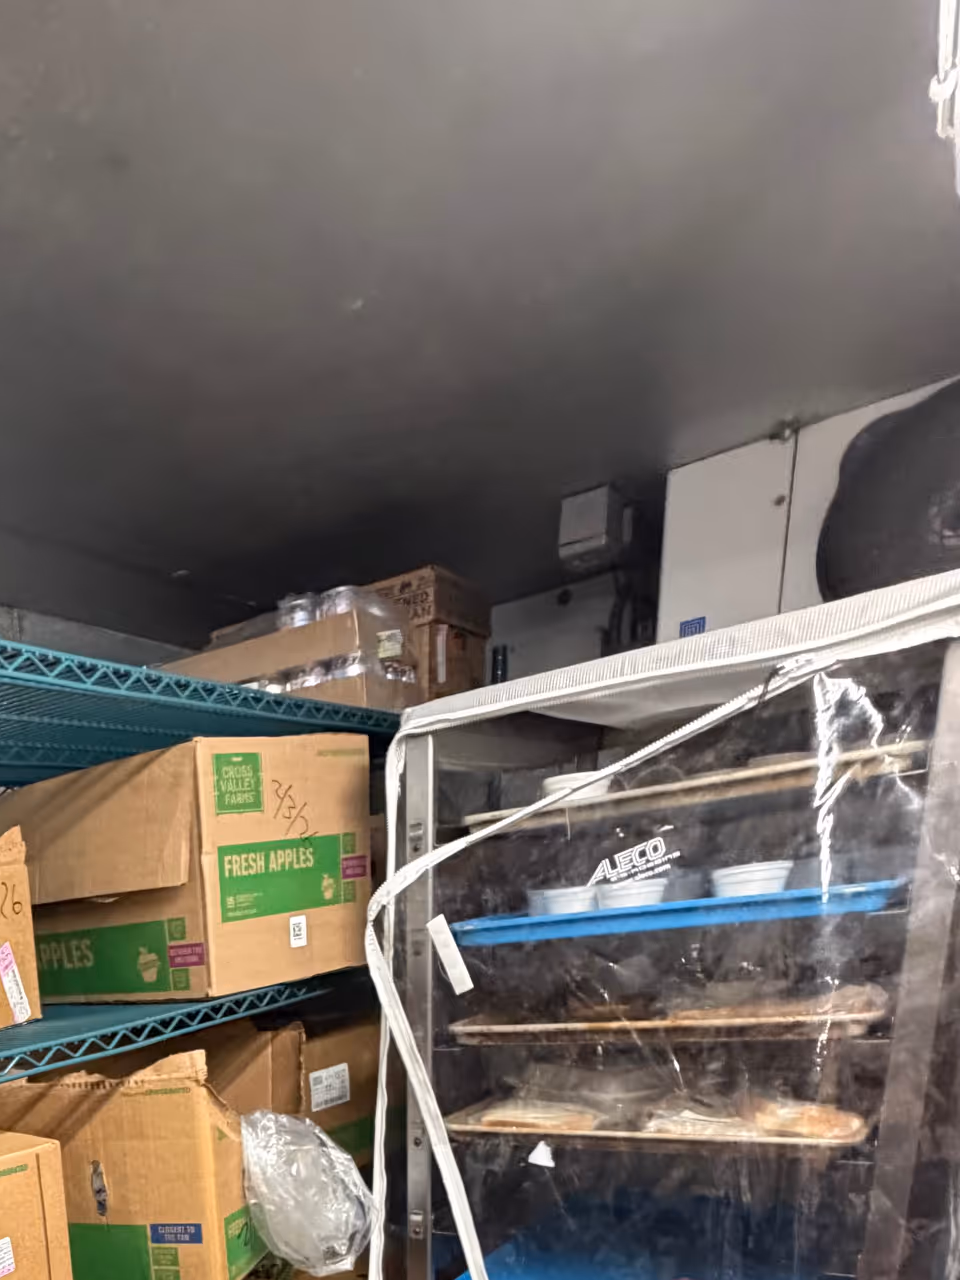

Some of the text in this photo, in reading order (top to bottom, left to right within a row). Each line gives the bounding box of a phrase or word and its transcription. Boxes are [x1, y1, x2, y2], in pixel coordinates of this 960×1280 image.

[222, 764, 253, 778] CROSS
[220, 778, 255, 791] VALLEY
[224, 852, 265, 878] FRESH
[269, 848, 314, 873] APPLES
[586, 837, 666, 888] ALECO
